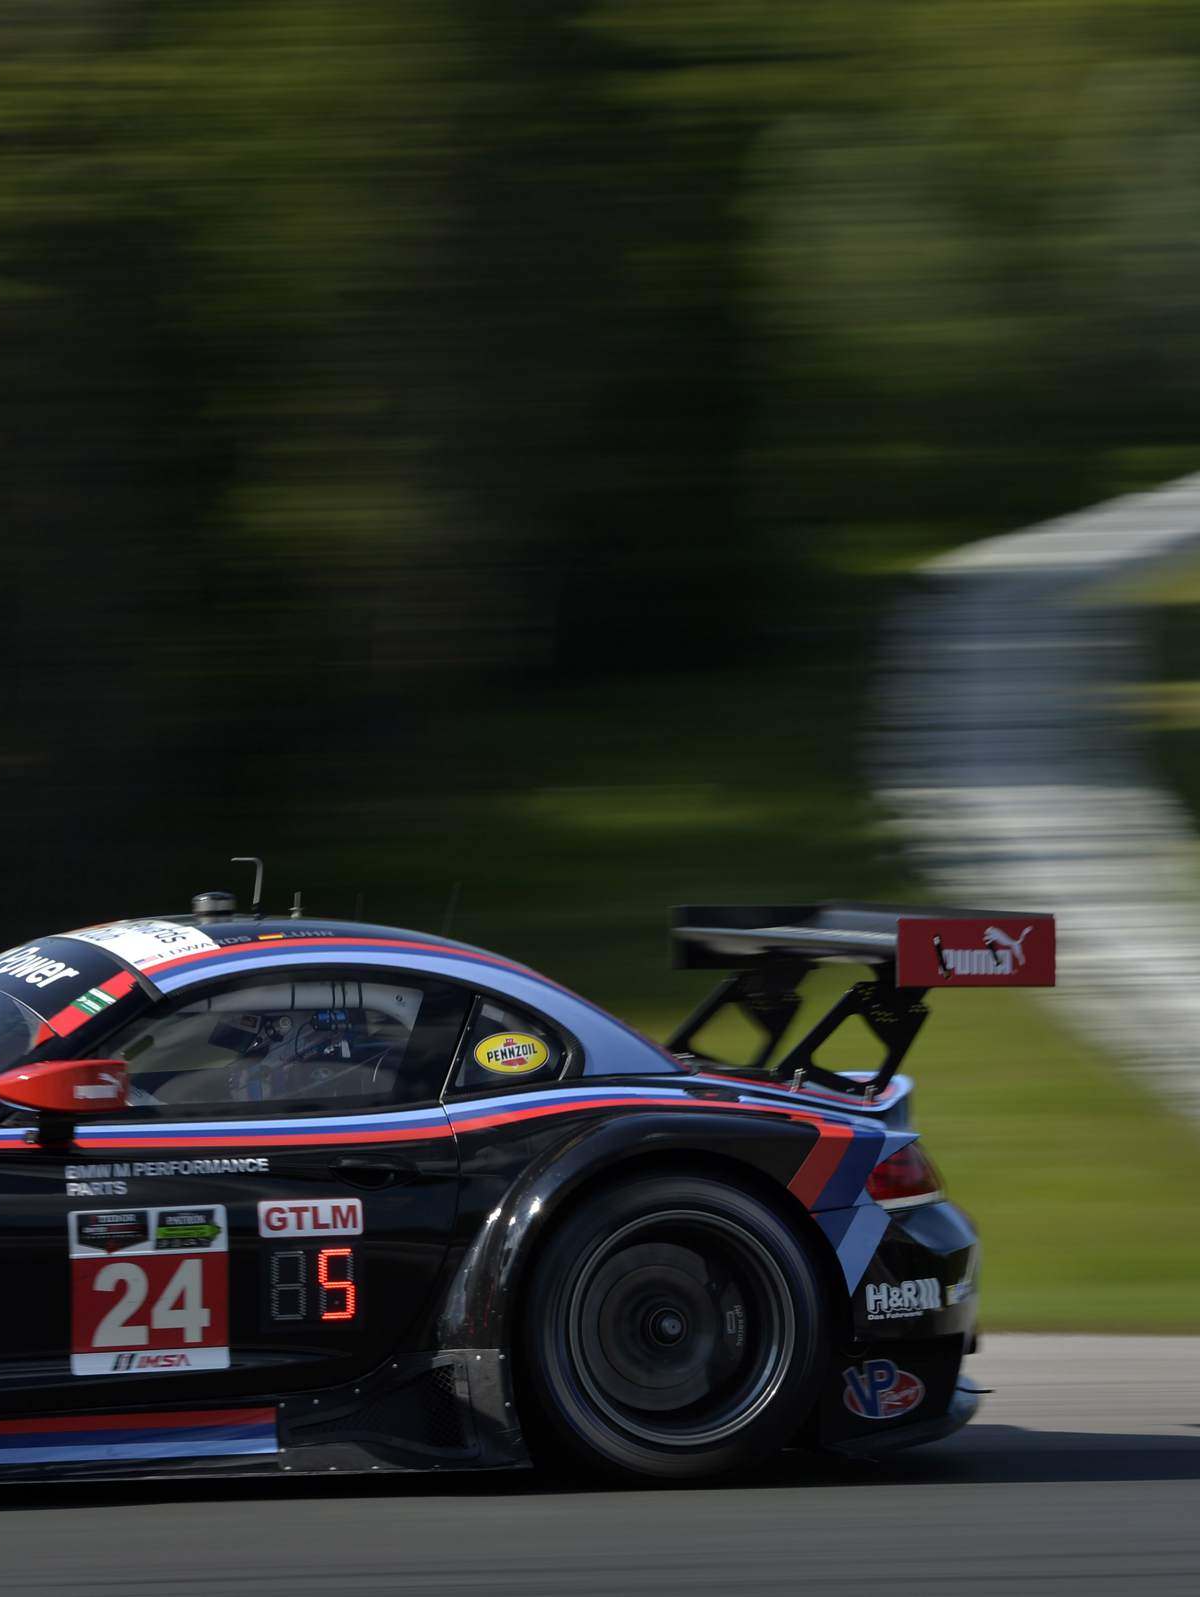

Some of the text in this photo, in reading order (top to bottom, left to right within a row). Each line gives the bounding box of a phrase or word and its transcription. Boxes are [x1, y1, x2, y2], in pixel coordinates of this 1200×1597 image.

[486, 1043, 538, 1063] PENNZOIL
[65, 1158, 269, 1179] BMW M PERFORMANCE
[66, 1181, 128, 1196] PARTS
[265, 1204, 358, 1231] GTLM
[92, 1259, 211, 1348] 24
